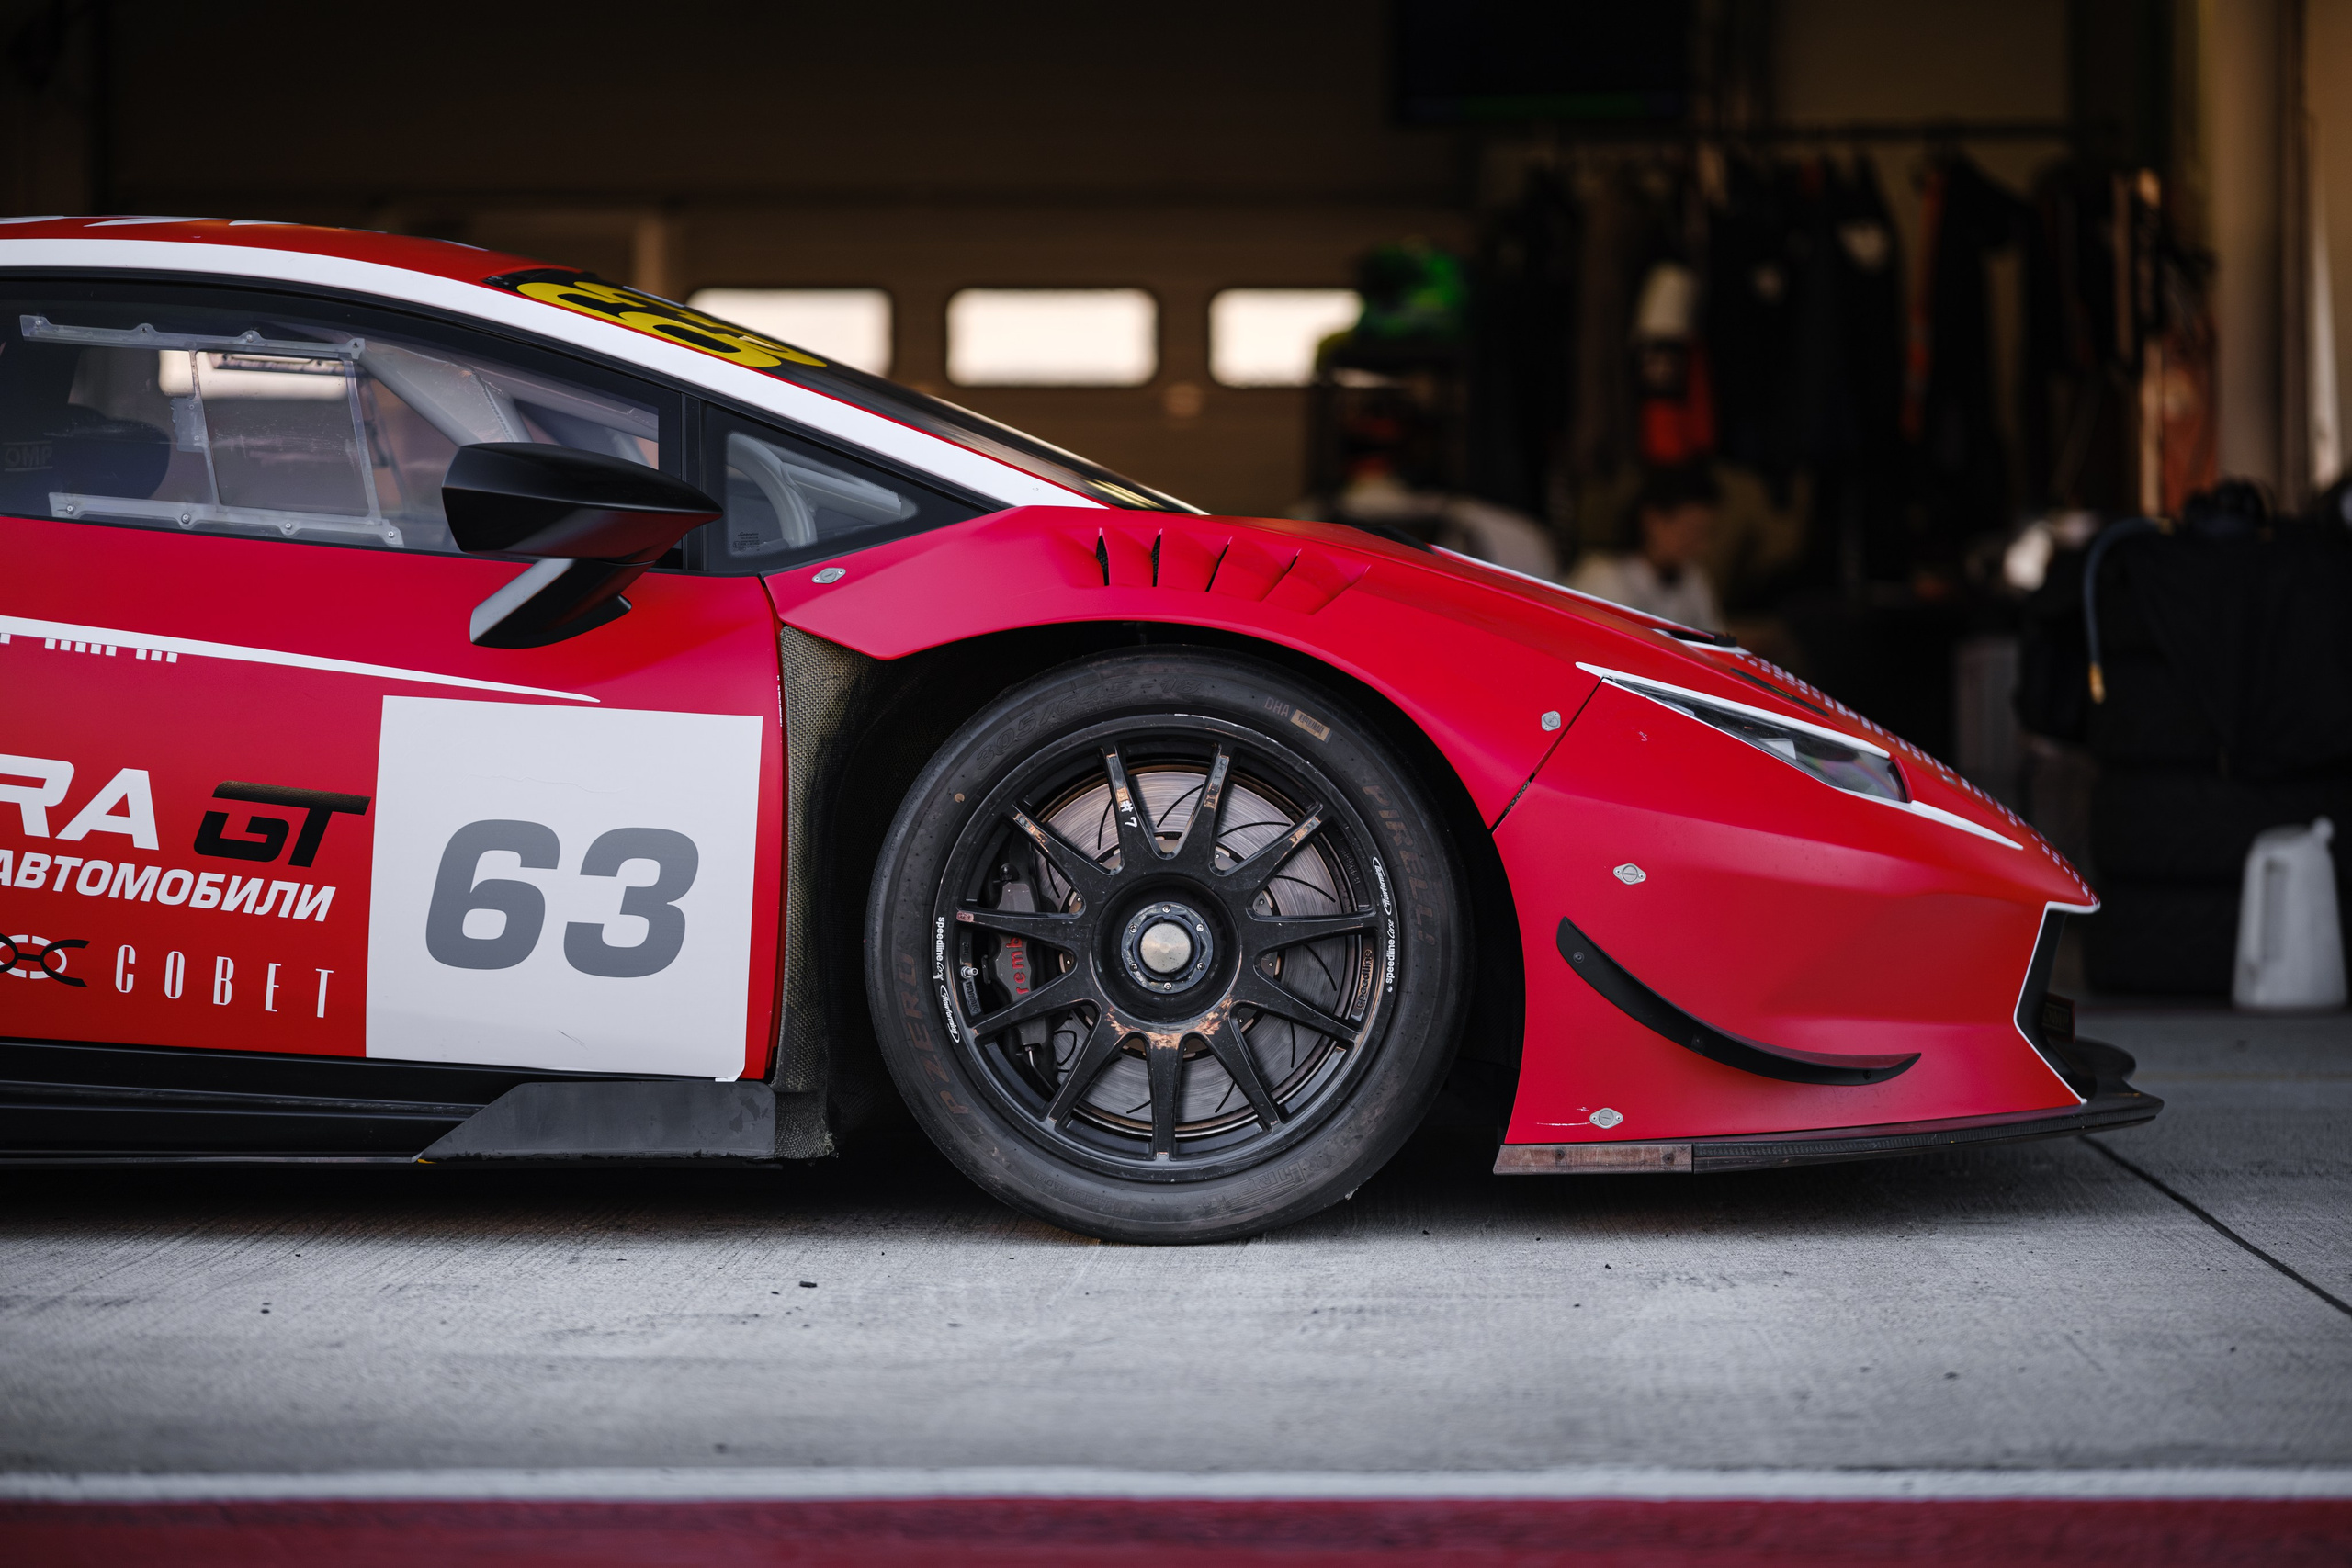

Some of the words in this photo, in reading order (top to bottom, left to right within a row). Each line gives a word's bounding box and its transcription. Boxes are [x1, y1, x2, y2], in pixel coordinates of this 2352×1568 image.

[4, 446, 53, 468] OMP
[1263, 696, 1290, 718] DHA
[194, 780, 371, 868] GT
[1362, 784, 1437, 946] PIRELLI
[425, 818, 700, 978] 63
[935, 916, 946, 962] speedline
[1385, 939, 1396, 985] speedline
[1006, 937, 1031, 996] remb
